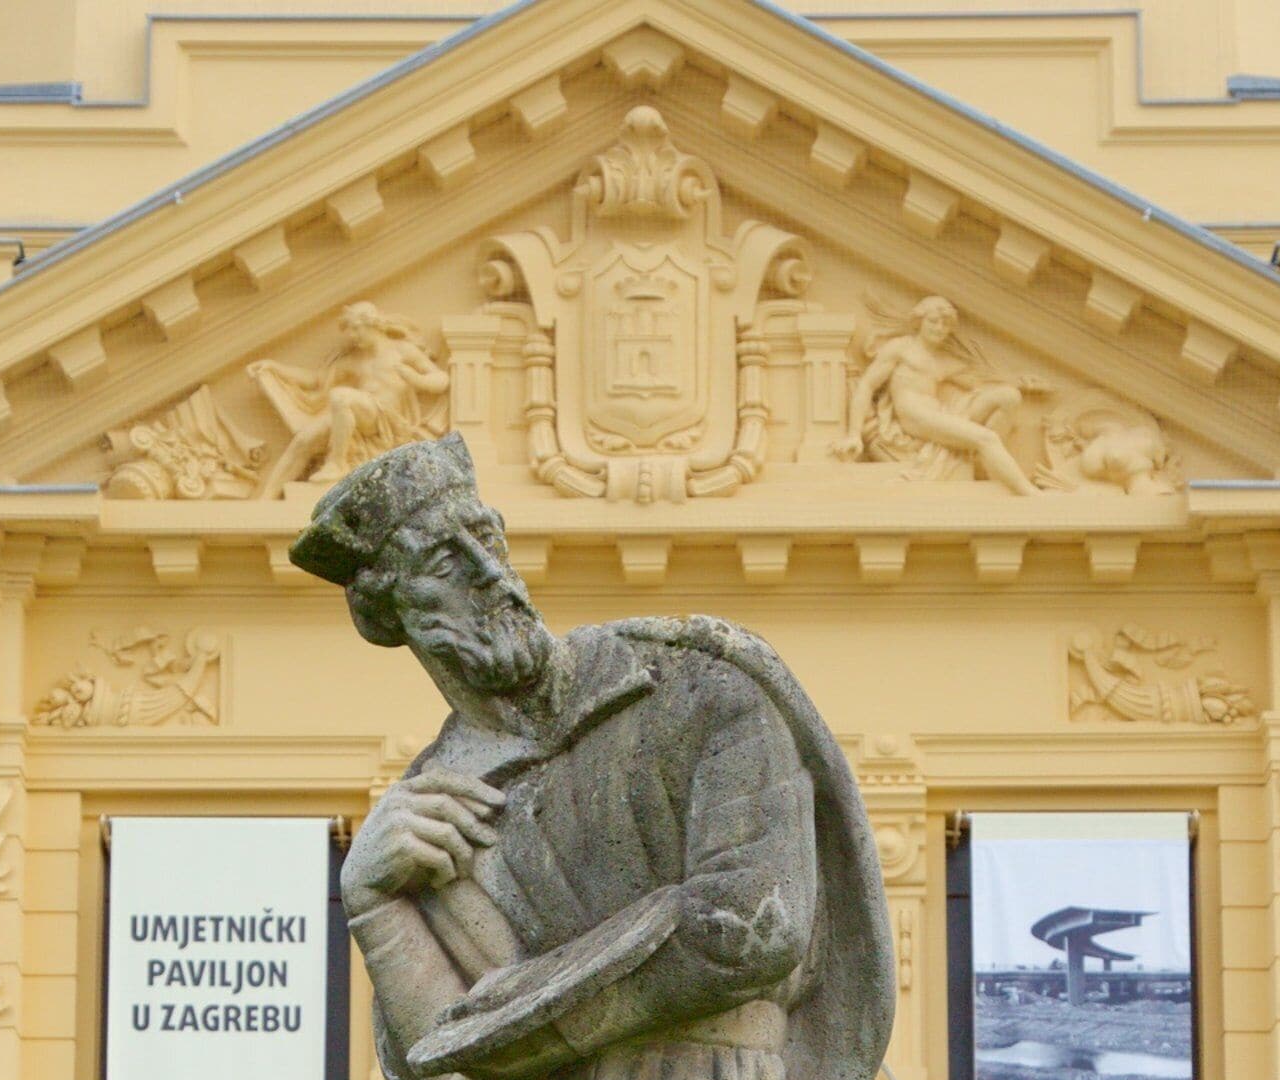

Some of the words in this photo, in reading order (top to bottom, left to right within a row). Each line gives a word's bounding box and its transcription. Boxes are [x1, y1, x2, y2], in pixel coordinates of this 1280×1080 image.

[130, 907, 307, 949] UMJETNIČKI
[147, 959, 288, 995] PAVILJON
[131, 1003, 151, 1032] U
[159, 1003, 302, 1033] ZAGREBU
